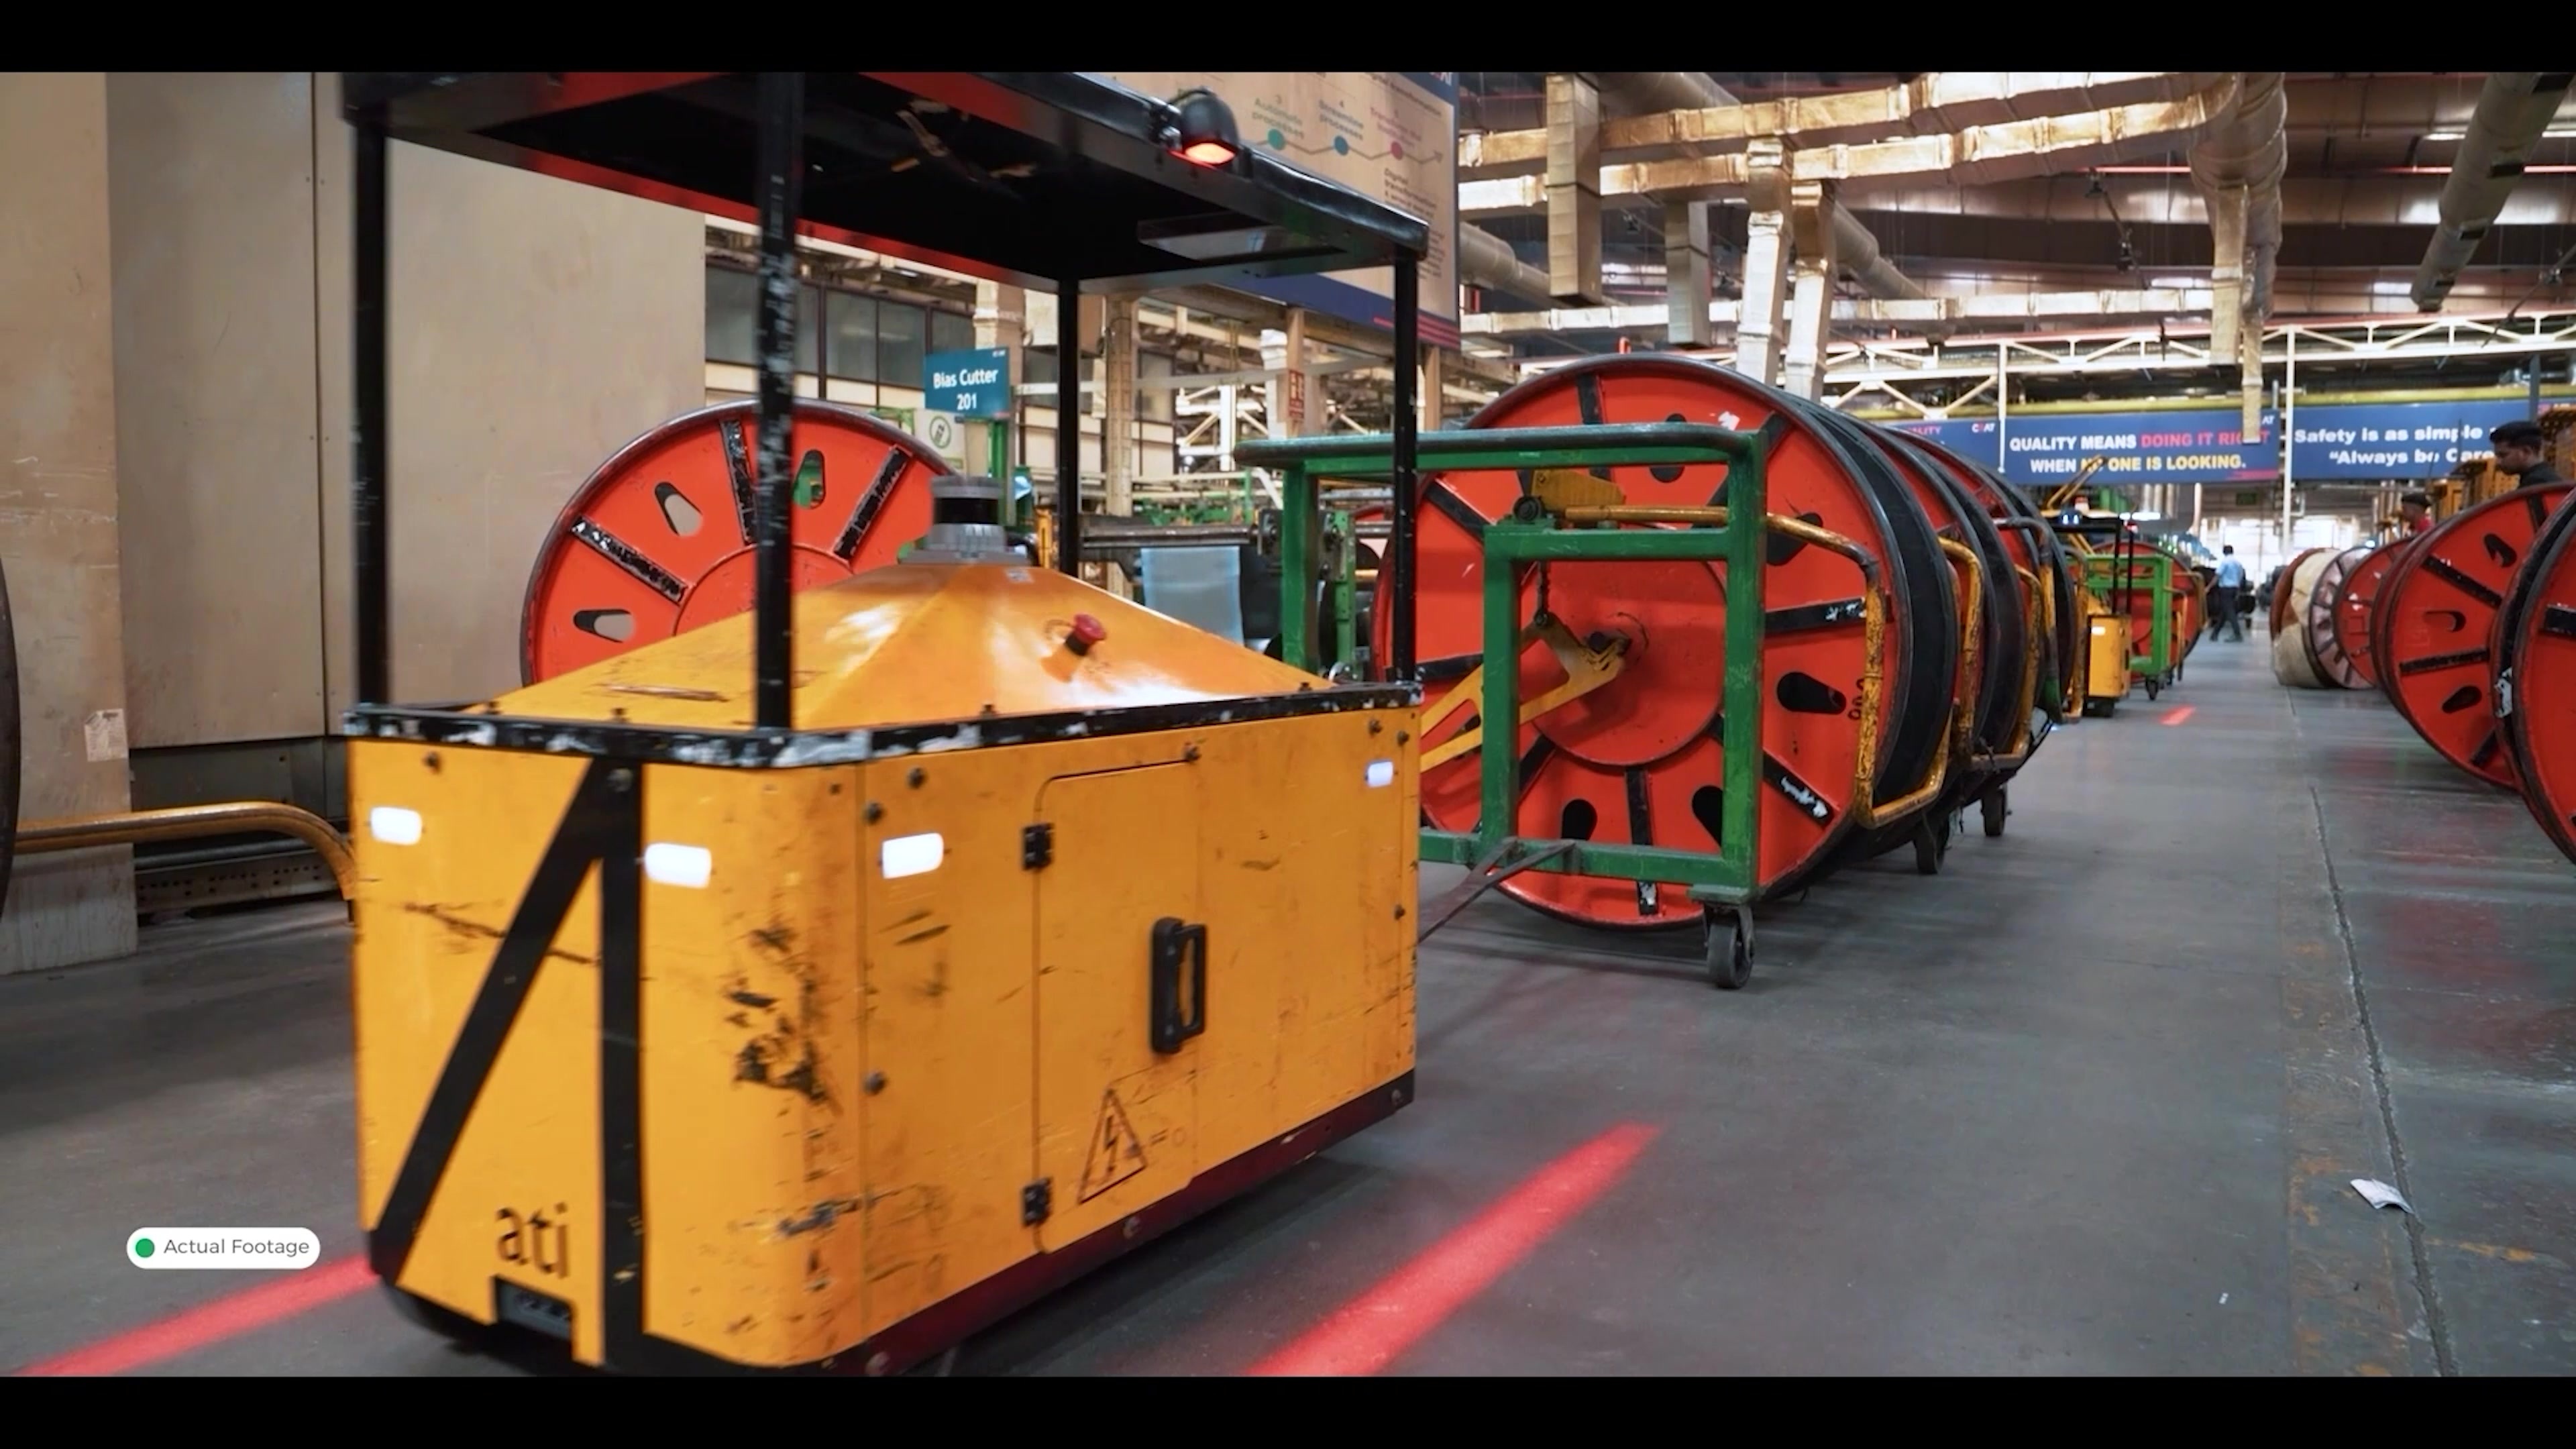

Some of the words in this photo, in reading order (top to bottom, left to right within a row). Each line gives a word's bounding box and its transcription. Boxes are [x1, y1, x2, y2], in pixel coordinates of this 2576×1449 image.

[933, 372, 957, 389] Bias
[959, 369, 999, 386] Cutter
[957, 393, 977, 410] 201
[2261, 415, 2275, 425] AT
[2009, 437, 2077, 451] QUALITY
[2080, 435, 2137, 450] MEANS
[2141, 433, 2193, 447] DOING
[2198, 431, 2213, 446] IT
[2218, 429, 2270, 445] RIGT
[2294, 429, 2356, 445] Safety
[2361, 427, 2379, 441] is
[2384, 429, 2408, 441] as
[2414, 424, 2483, 443] simple
[2030, 458, 2076, 473] WHEN
[2107, 457, 2142, 472] ONE
[2146, 456, 2161, 470] IS
[2166, 454, 2246, 470] LOOKING.
[2414, 448, 2440, 463] be
[2445, 447, 2496, 463] Care
[495, 1202, 569, 1279] ati
